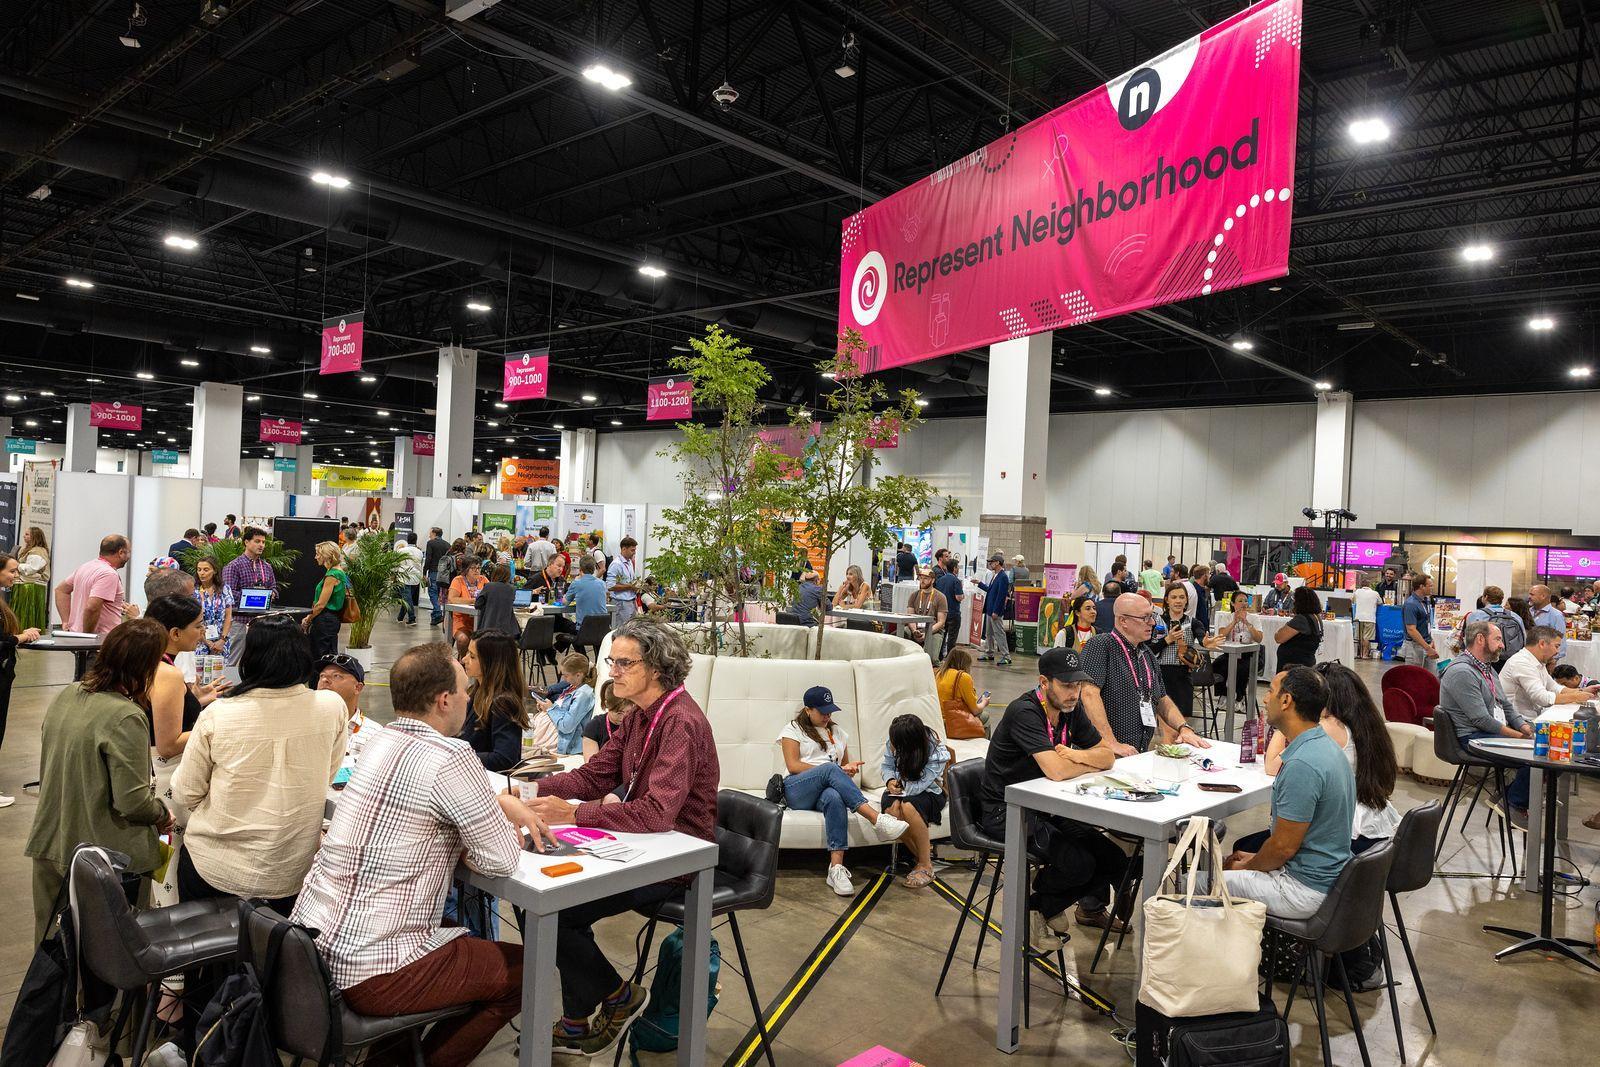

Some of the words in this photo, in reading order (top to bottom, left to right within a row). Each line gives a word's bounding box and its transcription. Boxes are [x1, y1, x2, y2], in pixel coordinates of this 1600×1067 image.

[1128, 78, 1151, 118] n
[894, 228, 1003, 295] Represent
[1011, 119, 1260, 250] Neighborhood
[333, 334, 351, 343] Represent
[328, 342, 356, 357] 700-800
[516, 366, 536, 375] Represent
[509, 373, 543, 387] 900-1000
[651, 396, 689, 408] 1100-1200
[96, 412, 137, 422] 900-1000
[263, 427, 299, 437] 1100-1200
[518, 463, 554, 471] Regenerate
[351, 475, 385, 483] Neighborhood
[517, 471, 560, 480] Neighborhoo
